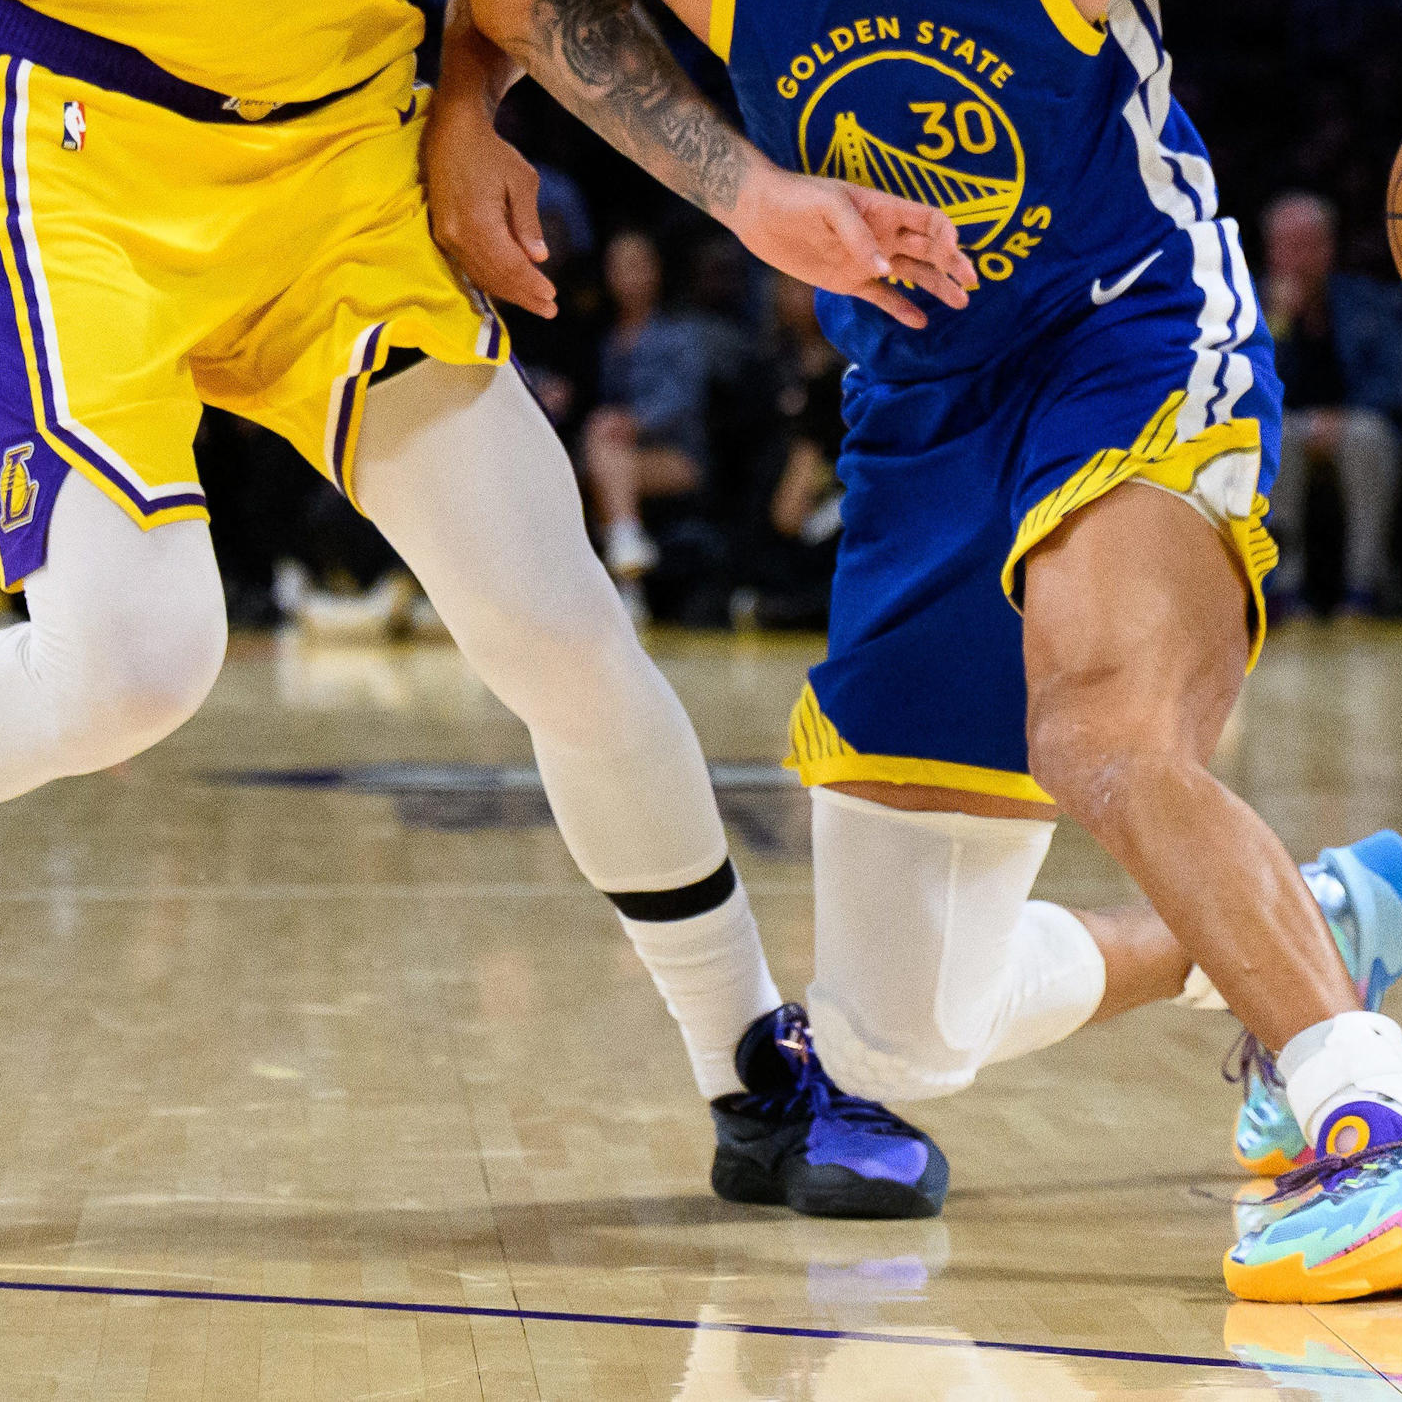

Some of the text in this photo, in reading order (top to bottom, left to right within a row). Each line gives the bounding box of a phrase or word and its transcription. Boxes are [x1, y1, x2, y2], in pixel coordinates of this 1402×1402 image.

[776, 16, 1015, 99] GOLDEN STATE
[908, 100, 997, 160] 30
